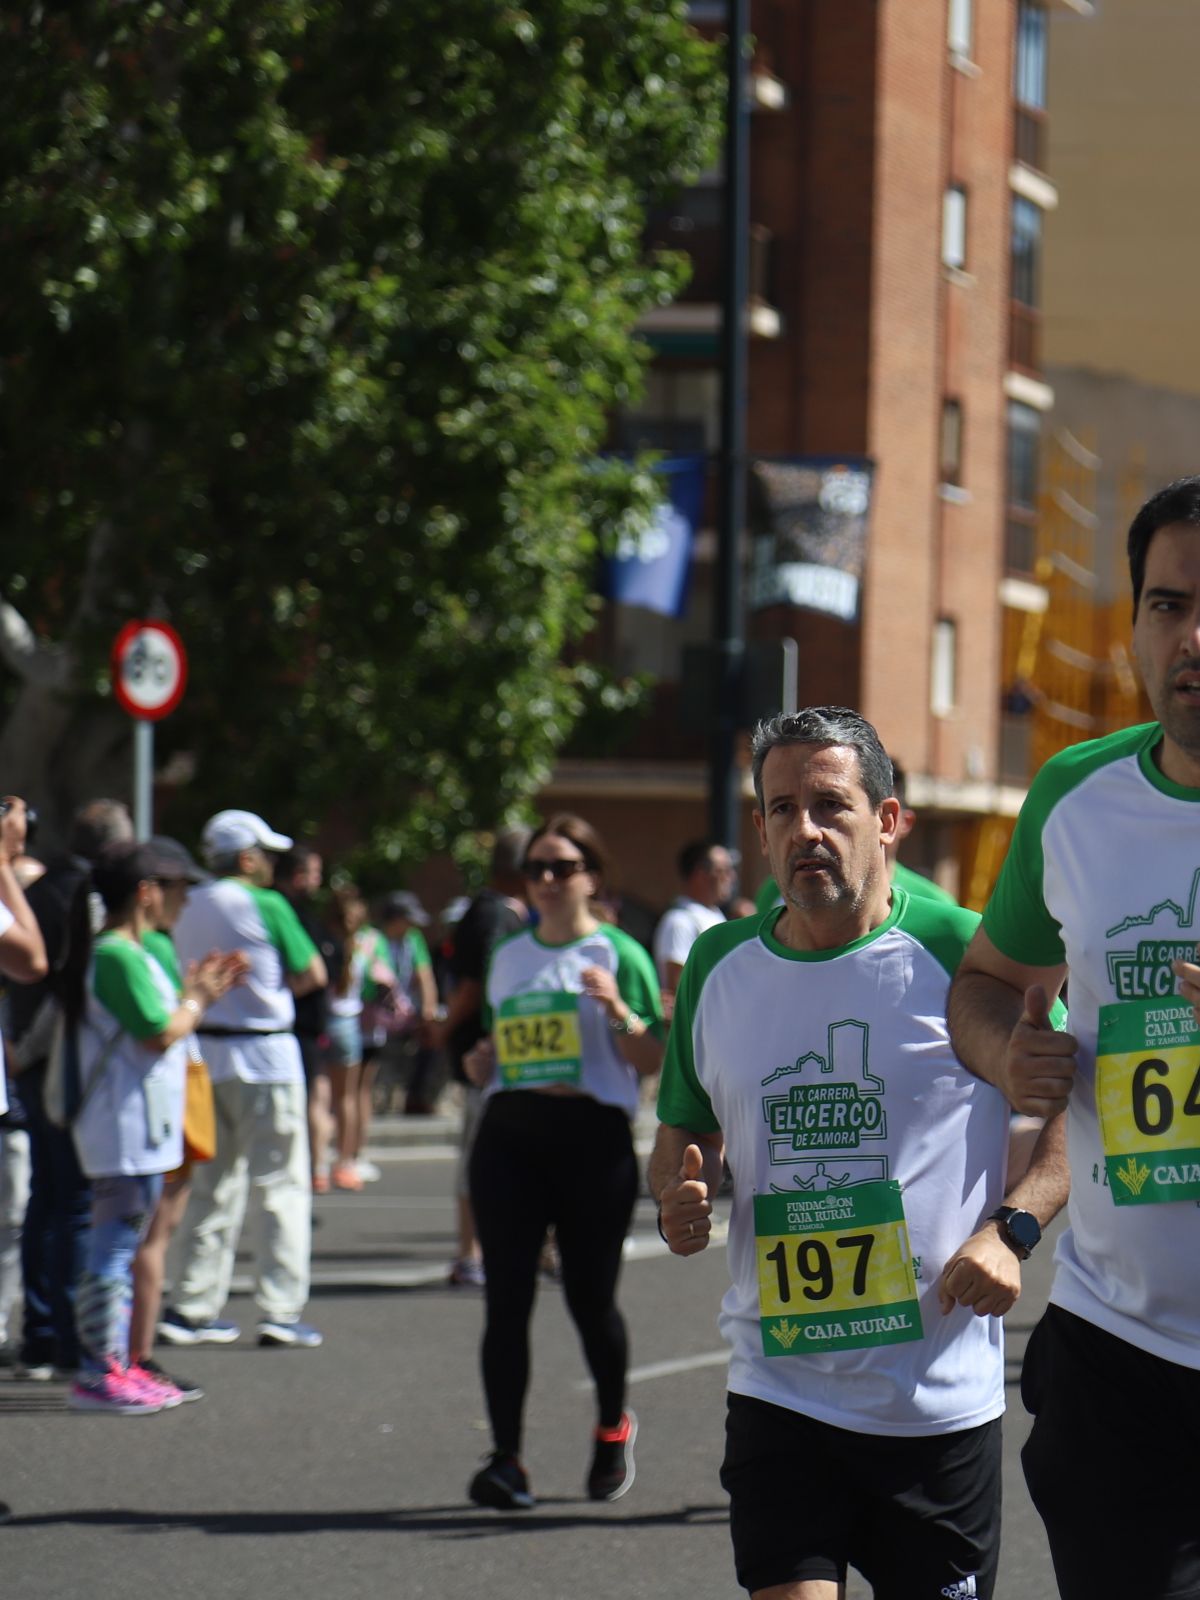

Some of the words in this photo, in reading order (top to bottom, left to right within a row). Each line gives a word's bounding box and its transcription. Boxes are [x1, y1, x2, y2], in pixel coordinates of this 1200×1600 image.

[1141, 946, 1154, 961] IX
[1119, 966, 1145, 996] EL
[1144, 1006, 1195, 1023] FUNDAC
[503, 1020, 568, 1056] 1342
[1145, 1022, 1176, 1037] CAJA
[1145, 1039, 1156, 1047] DE
[1158, 1035, 1191, 1045] ZAMORA
[794, 1089, 805, 1103] IX
[807, 1086, 856, 1102] CARRERA
[774, 1105, 797, 1130] EL
[804, 1100, 878, 1129] CERCO
[796, 1132, 808, 1147] DE
[809, 1131, 857, 1146] ZAMORA
[787, 1212, 813, 1224] CAJA
[814, 1207, 856, 1222] RURAL
[765, 1233, 875, 1303] 197
[803, 1323, 847, 1340] CAJA
[849, 1313, 913, 1337] RURAL
